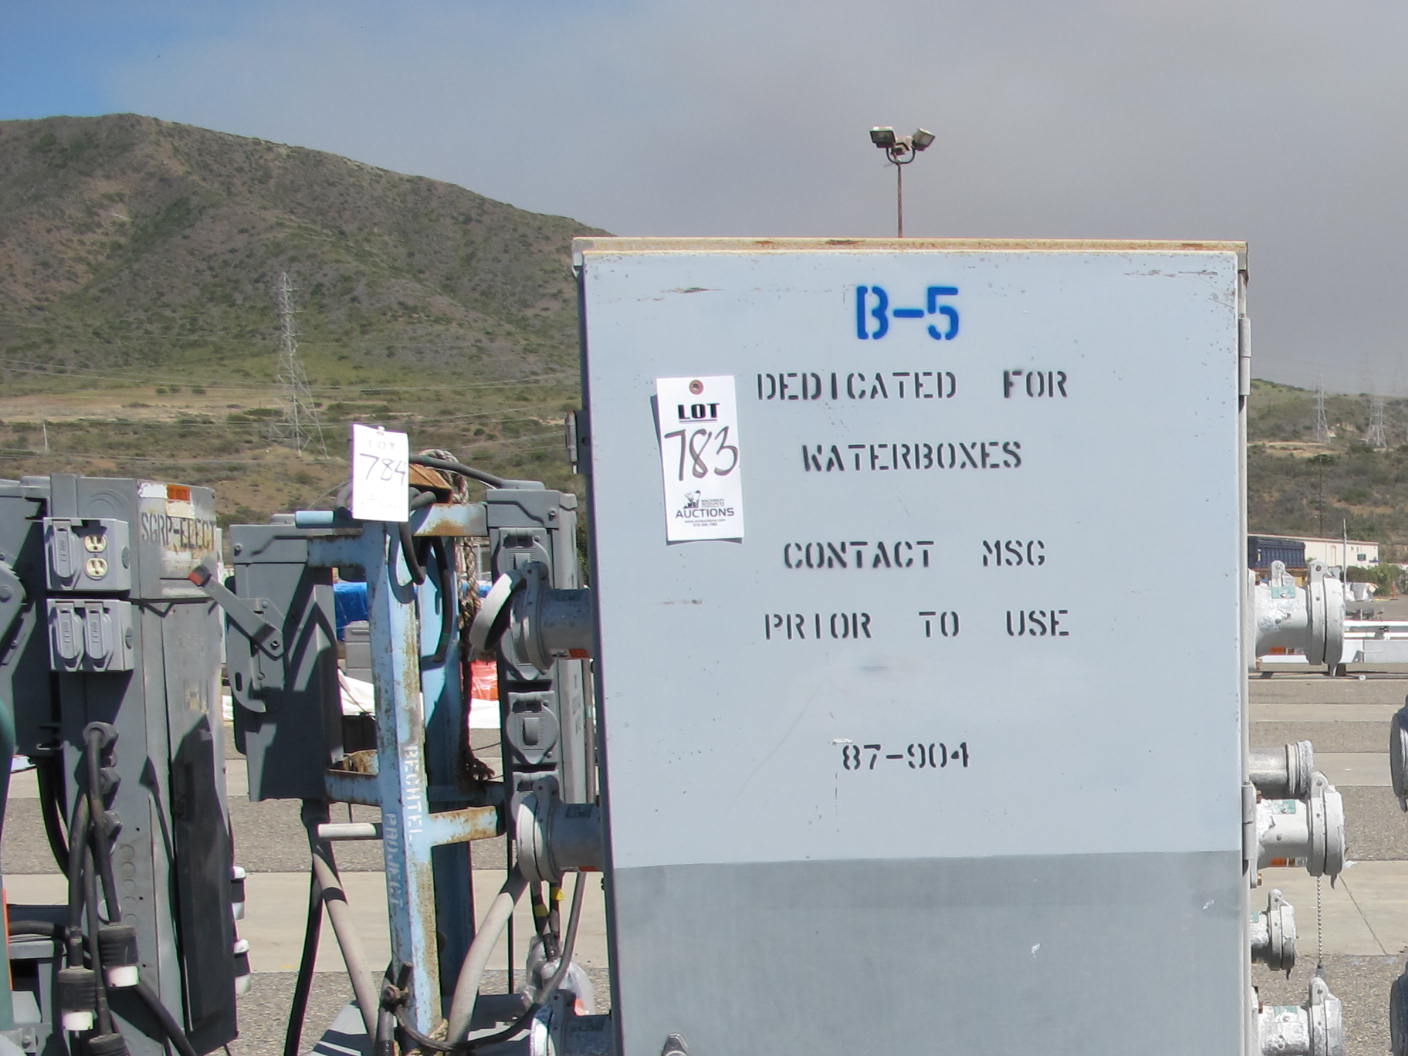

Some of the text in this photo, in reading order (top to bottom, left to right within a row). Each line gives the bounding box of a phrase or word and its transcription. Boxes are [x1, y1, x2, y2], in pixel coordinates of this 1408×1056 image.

[856, 285, 959, 341] B-5
[757, 370, 1068, 401] DEDICATED FOR
[677, 403, 720, 420] LOT
[664, 426, 738, 481] 783
[802, 441, 1022, 473] WATERBOXES
[359, 453, 406, 486] 784
[675, 507, 735, 519] AUCTIONS
[783, 539, 1046, 569] CONTACT MSG
[764, 609, 1070, 640] PRIOR TO USE
[842, 741, 969, 771] 87-904
[404, 744, 423, 841] BECHTEL
